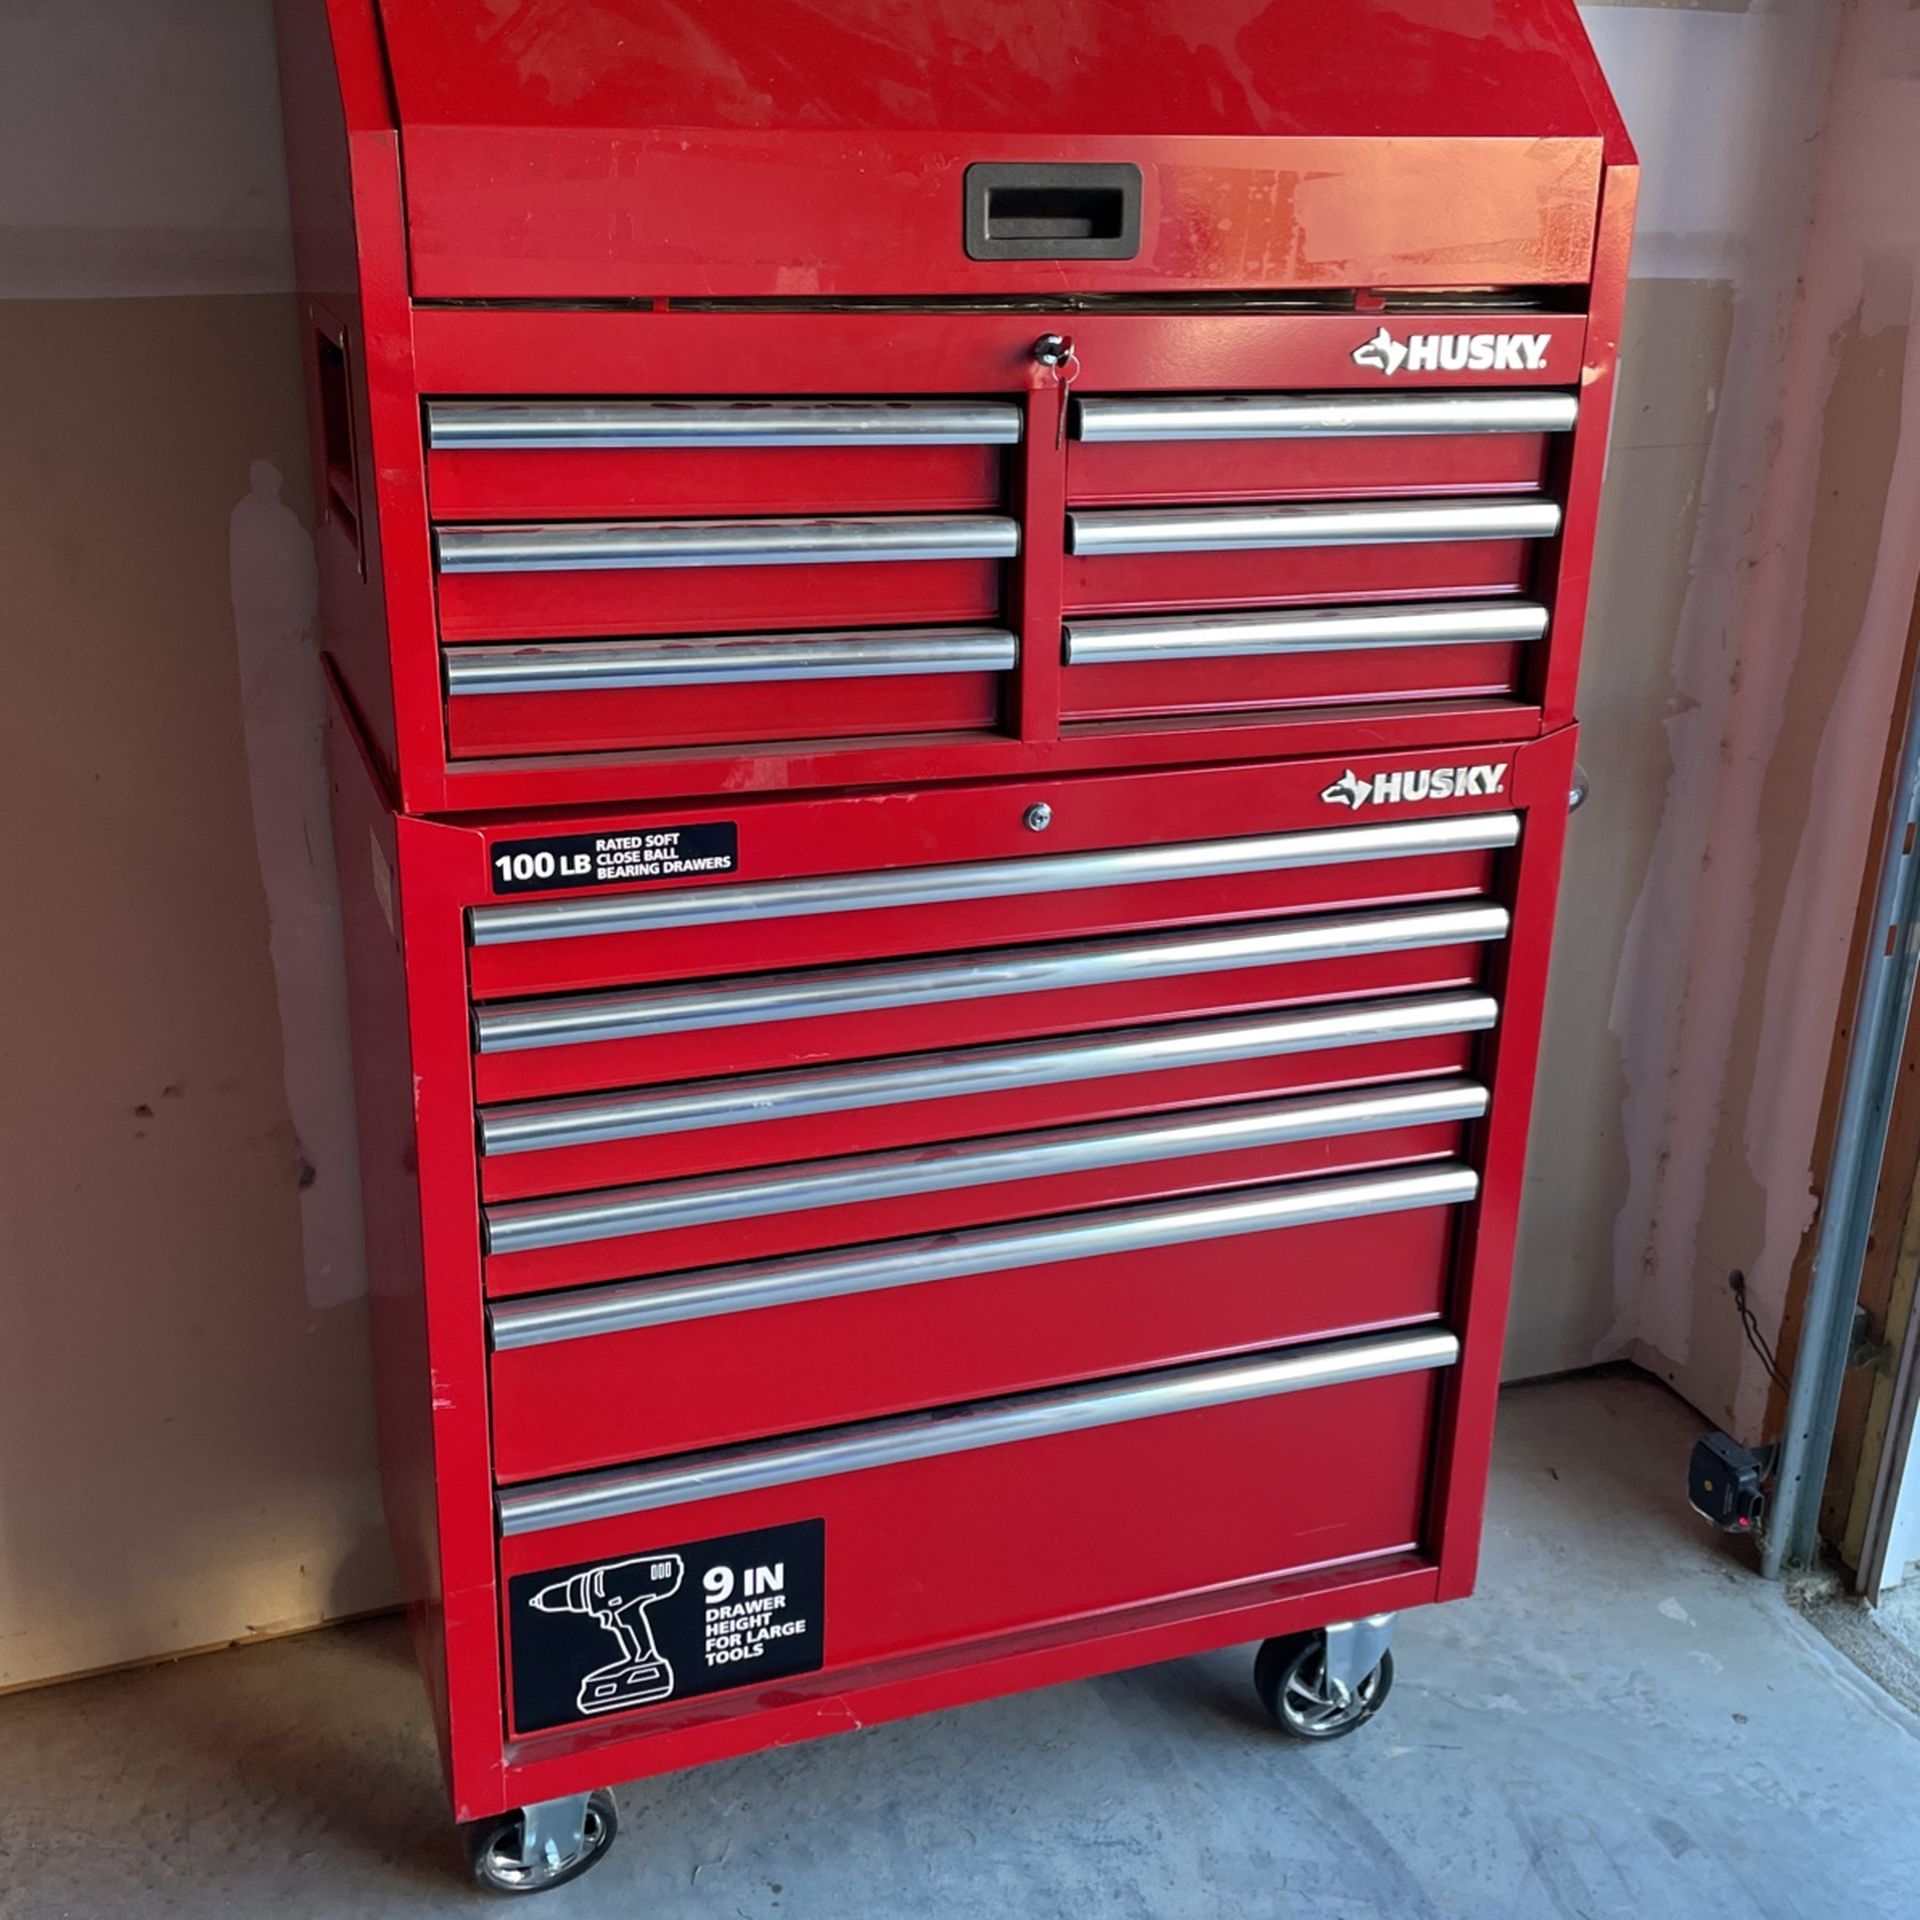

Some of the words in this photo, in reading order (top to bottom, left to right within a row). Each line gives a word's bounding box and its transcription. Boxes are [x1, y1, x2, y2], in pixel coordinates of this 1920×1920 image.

[596, 837, 642, 852] RATED
[645, 832, 680, 847] SOFT
[495, 852, 555, 881] 100
[560, 854, 592, 876] LB
[596, 850, 641, 866] CLOSE
[644, 847, 679, 861] BALL
[597, 862, 660, 880] BEARING
[663, 856, 732, 874] DRAWERS
[702, 1566, 734, 1604] 9
[743, 1563, 785, 1596] IN
[705, 1595, 786, 1623] DRAWER
[705, 1613, 773, 1638] HEIGHT
[705, 1633, 742, 1652] FOR
[746, 1620, 806, 1644] LARGE
[705, 1643, 764, 1667] TOOLS
